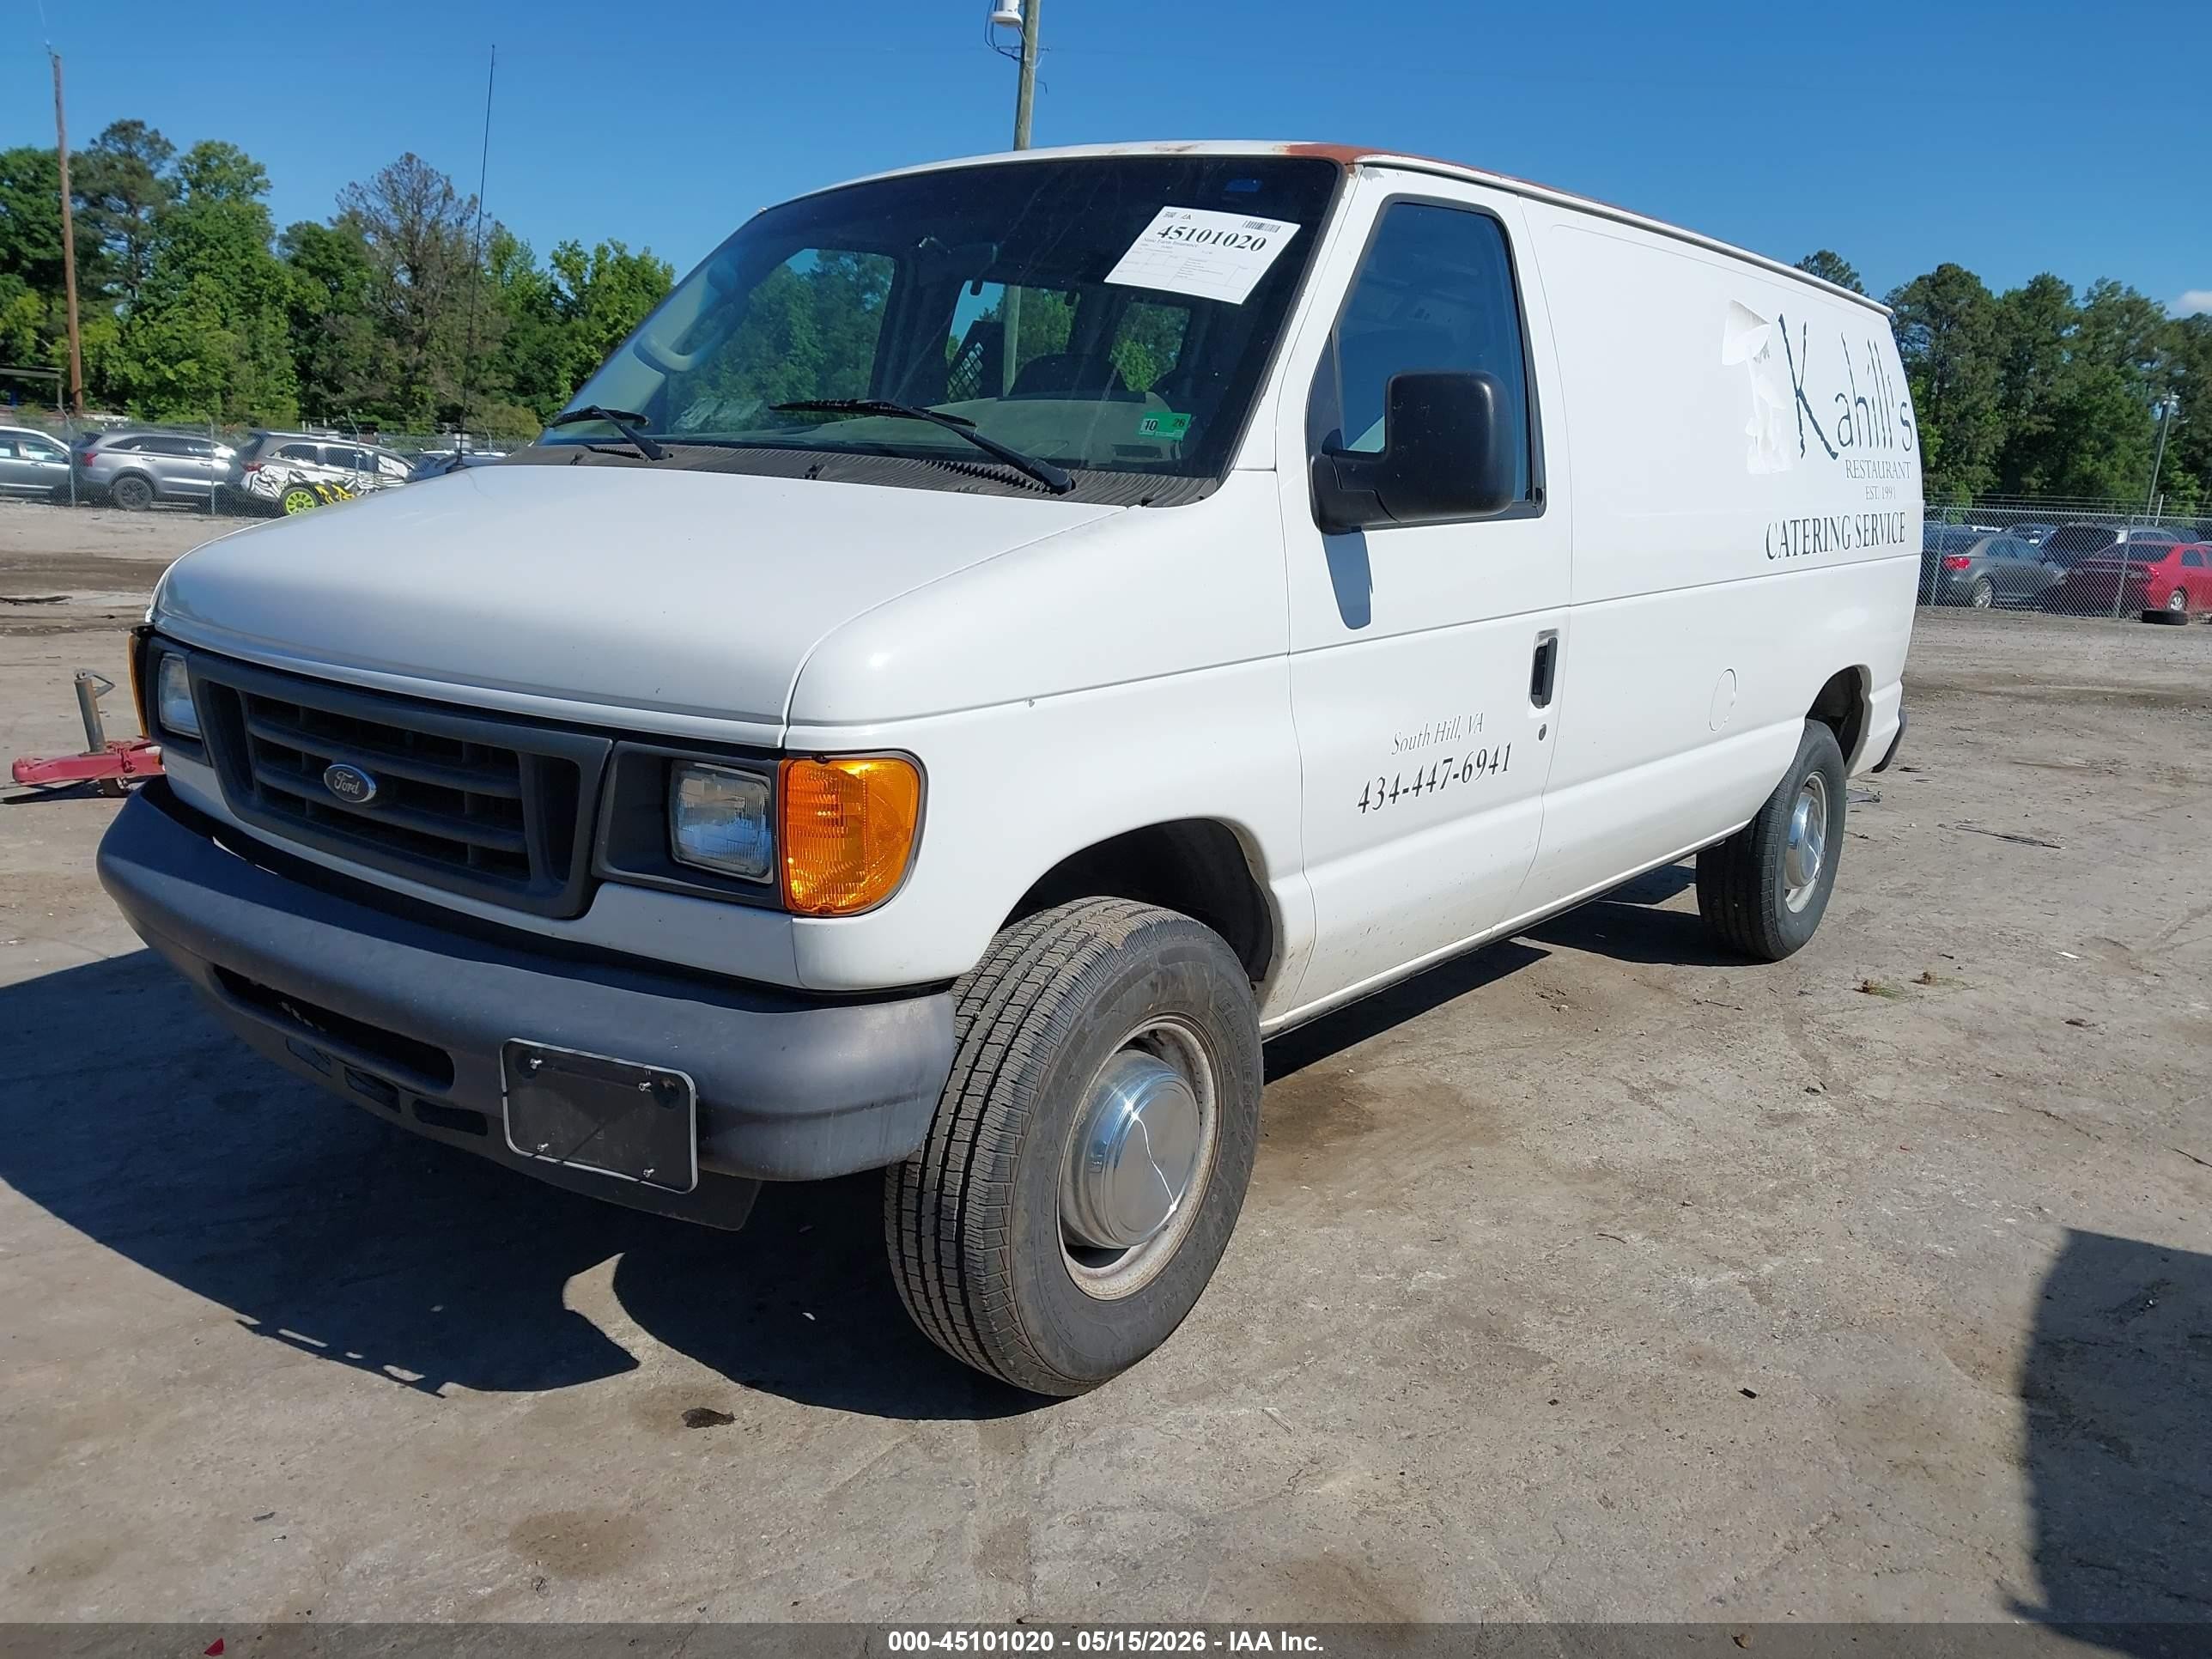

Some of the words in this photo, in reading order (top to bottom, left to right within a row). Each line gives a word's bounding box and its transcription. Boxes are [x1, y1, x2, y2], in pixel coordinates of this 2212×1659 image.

[1157, 224, 1267, 252] 45101020
[1778, 313, 1913, 461] Kahill's
[1144, 419, 1158, 431] 10
[1844, 459, 1911, 479] RESTAURANT
[1865, 486, 1880, 500] EST.
[1765, 514, 1852, 561] CATERING
[1855, 513, 1905, 548] SERVICE
[1391, 723, 1430, 756] South
[1433, 715, 1462, 744] Hill,
[1468, 713, 1484, 735] VA
[334, 771, 361, 795] Ford
[1357, 741, 1512, 815] 434-447-6941
